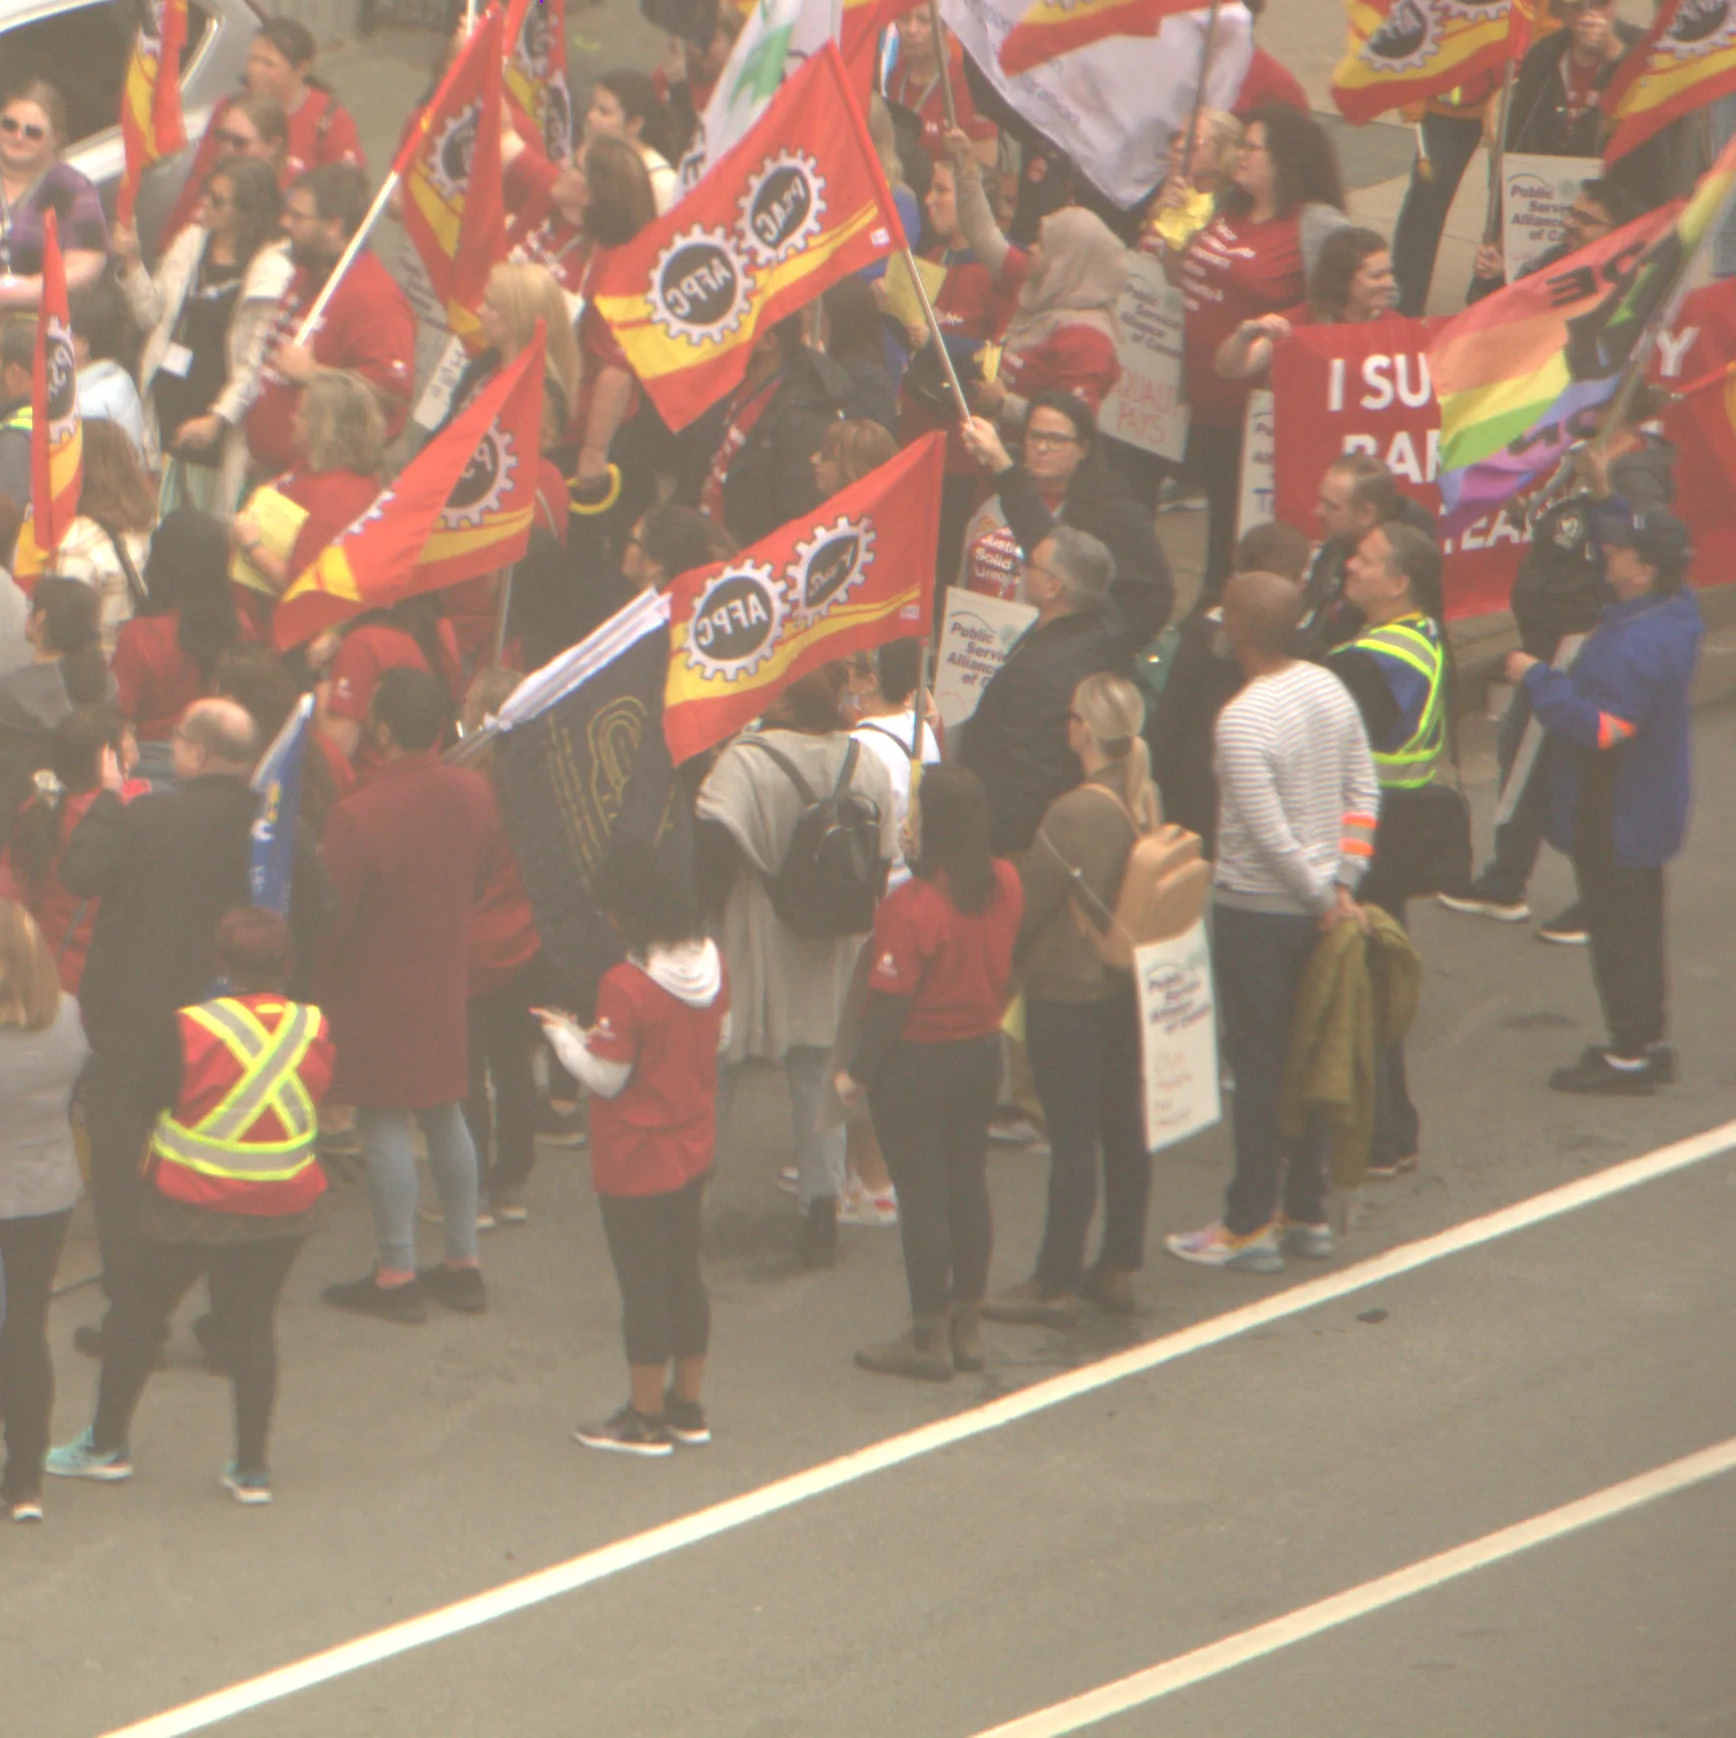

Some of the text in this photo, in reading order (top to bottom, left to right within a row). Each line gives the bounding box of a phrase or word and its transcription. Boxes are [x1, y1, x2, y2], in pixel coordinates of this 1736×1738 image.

[1328, 357, 1345, 412] I
[951, 621, 994, 645] Public
[947, 651, 997, 676] Allianc
[961, 672, 977, 687] of
